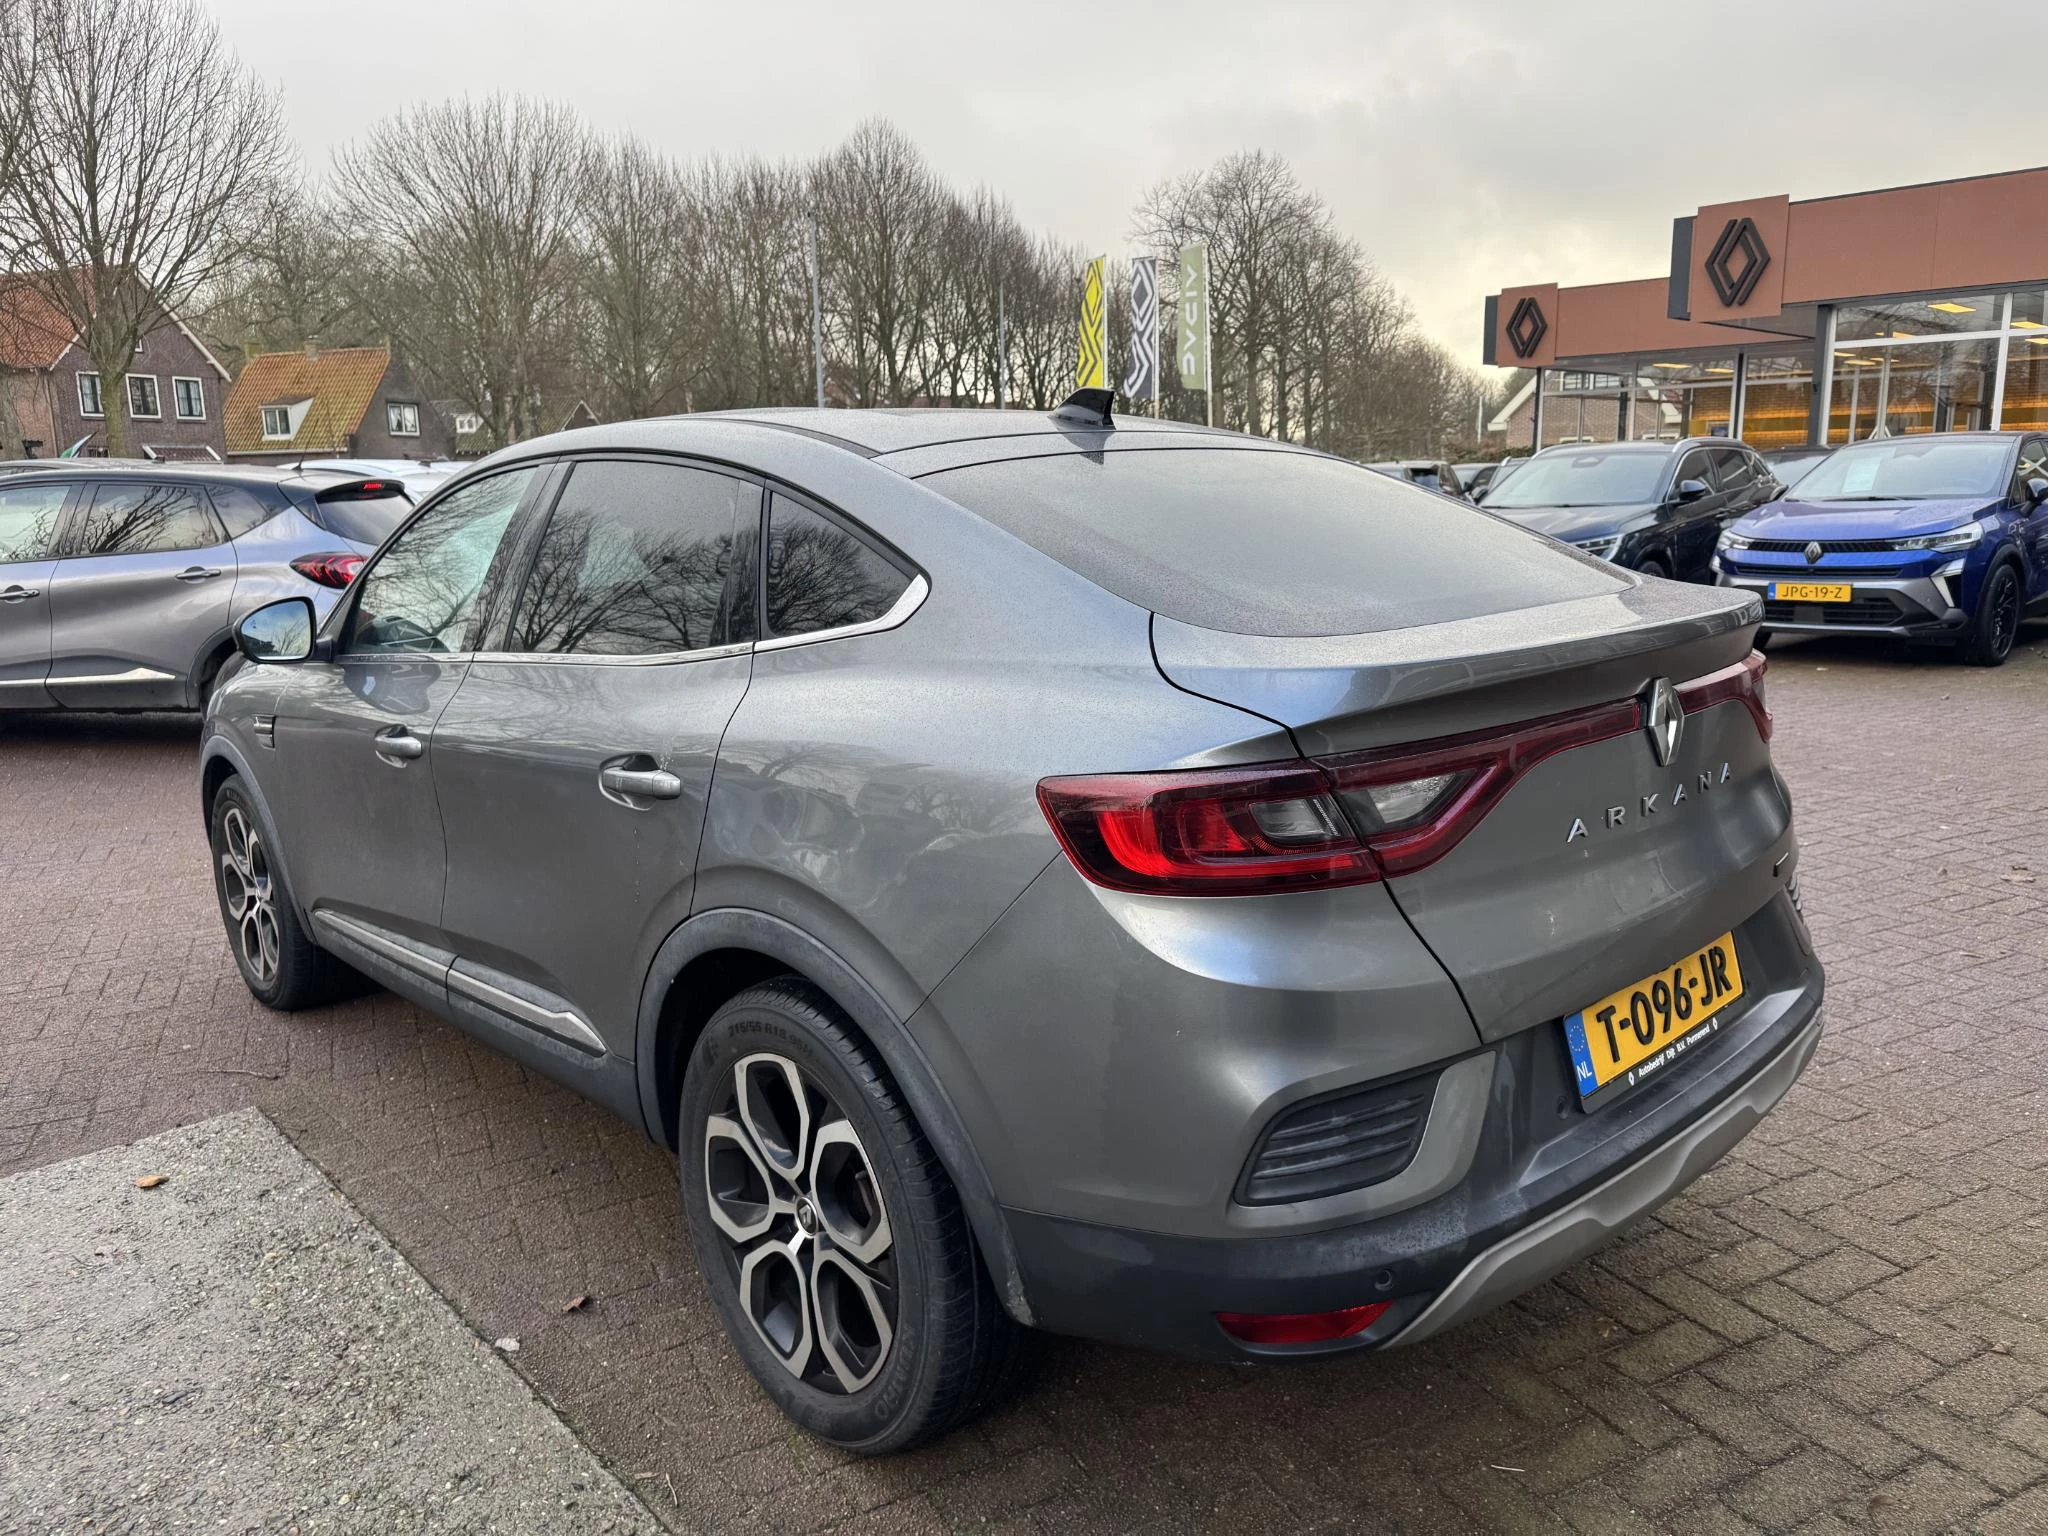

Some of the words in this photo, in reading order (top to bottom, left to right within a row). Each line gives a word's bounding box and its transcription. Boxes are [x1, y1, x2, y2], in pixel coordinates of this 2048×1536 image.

[1782, 585, 1842, 599] JPG-19-Z
[1566, 762, 1731, 843] ARKANA
[1596, 946, 1732, 1063] T-096-JR
[1576, 1061, 1592, 1082] NL
